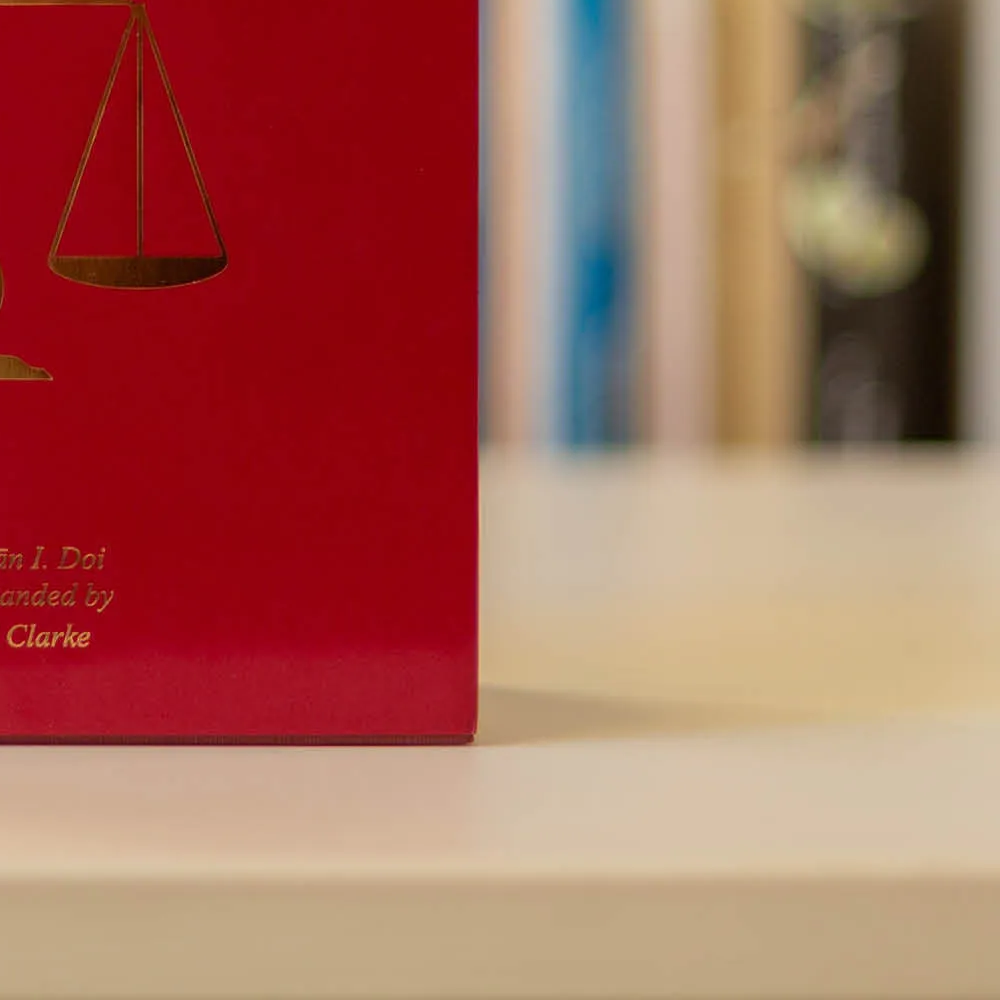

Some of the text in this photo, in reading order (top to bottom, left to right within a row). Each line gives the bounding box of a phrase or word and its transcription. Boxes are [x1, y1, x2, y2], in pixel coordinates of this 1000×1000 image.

[30, 546, 47, 570] I.
[57, 546, 106, 570] Doi
[84, 583, 114, 613] by
[5, 623, 92, 649] Clarke
